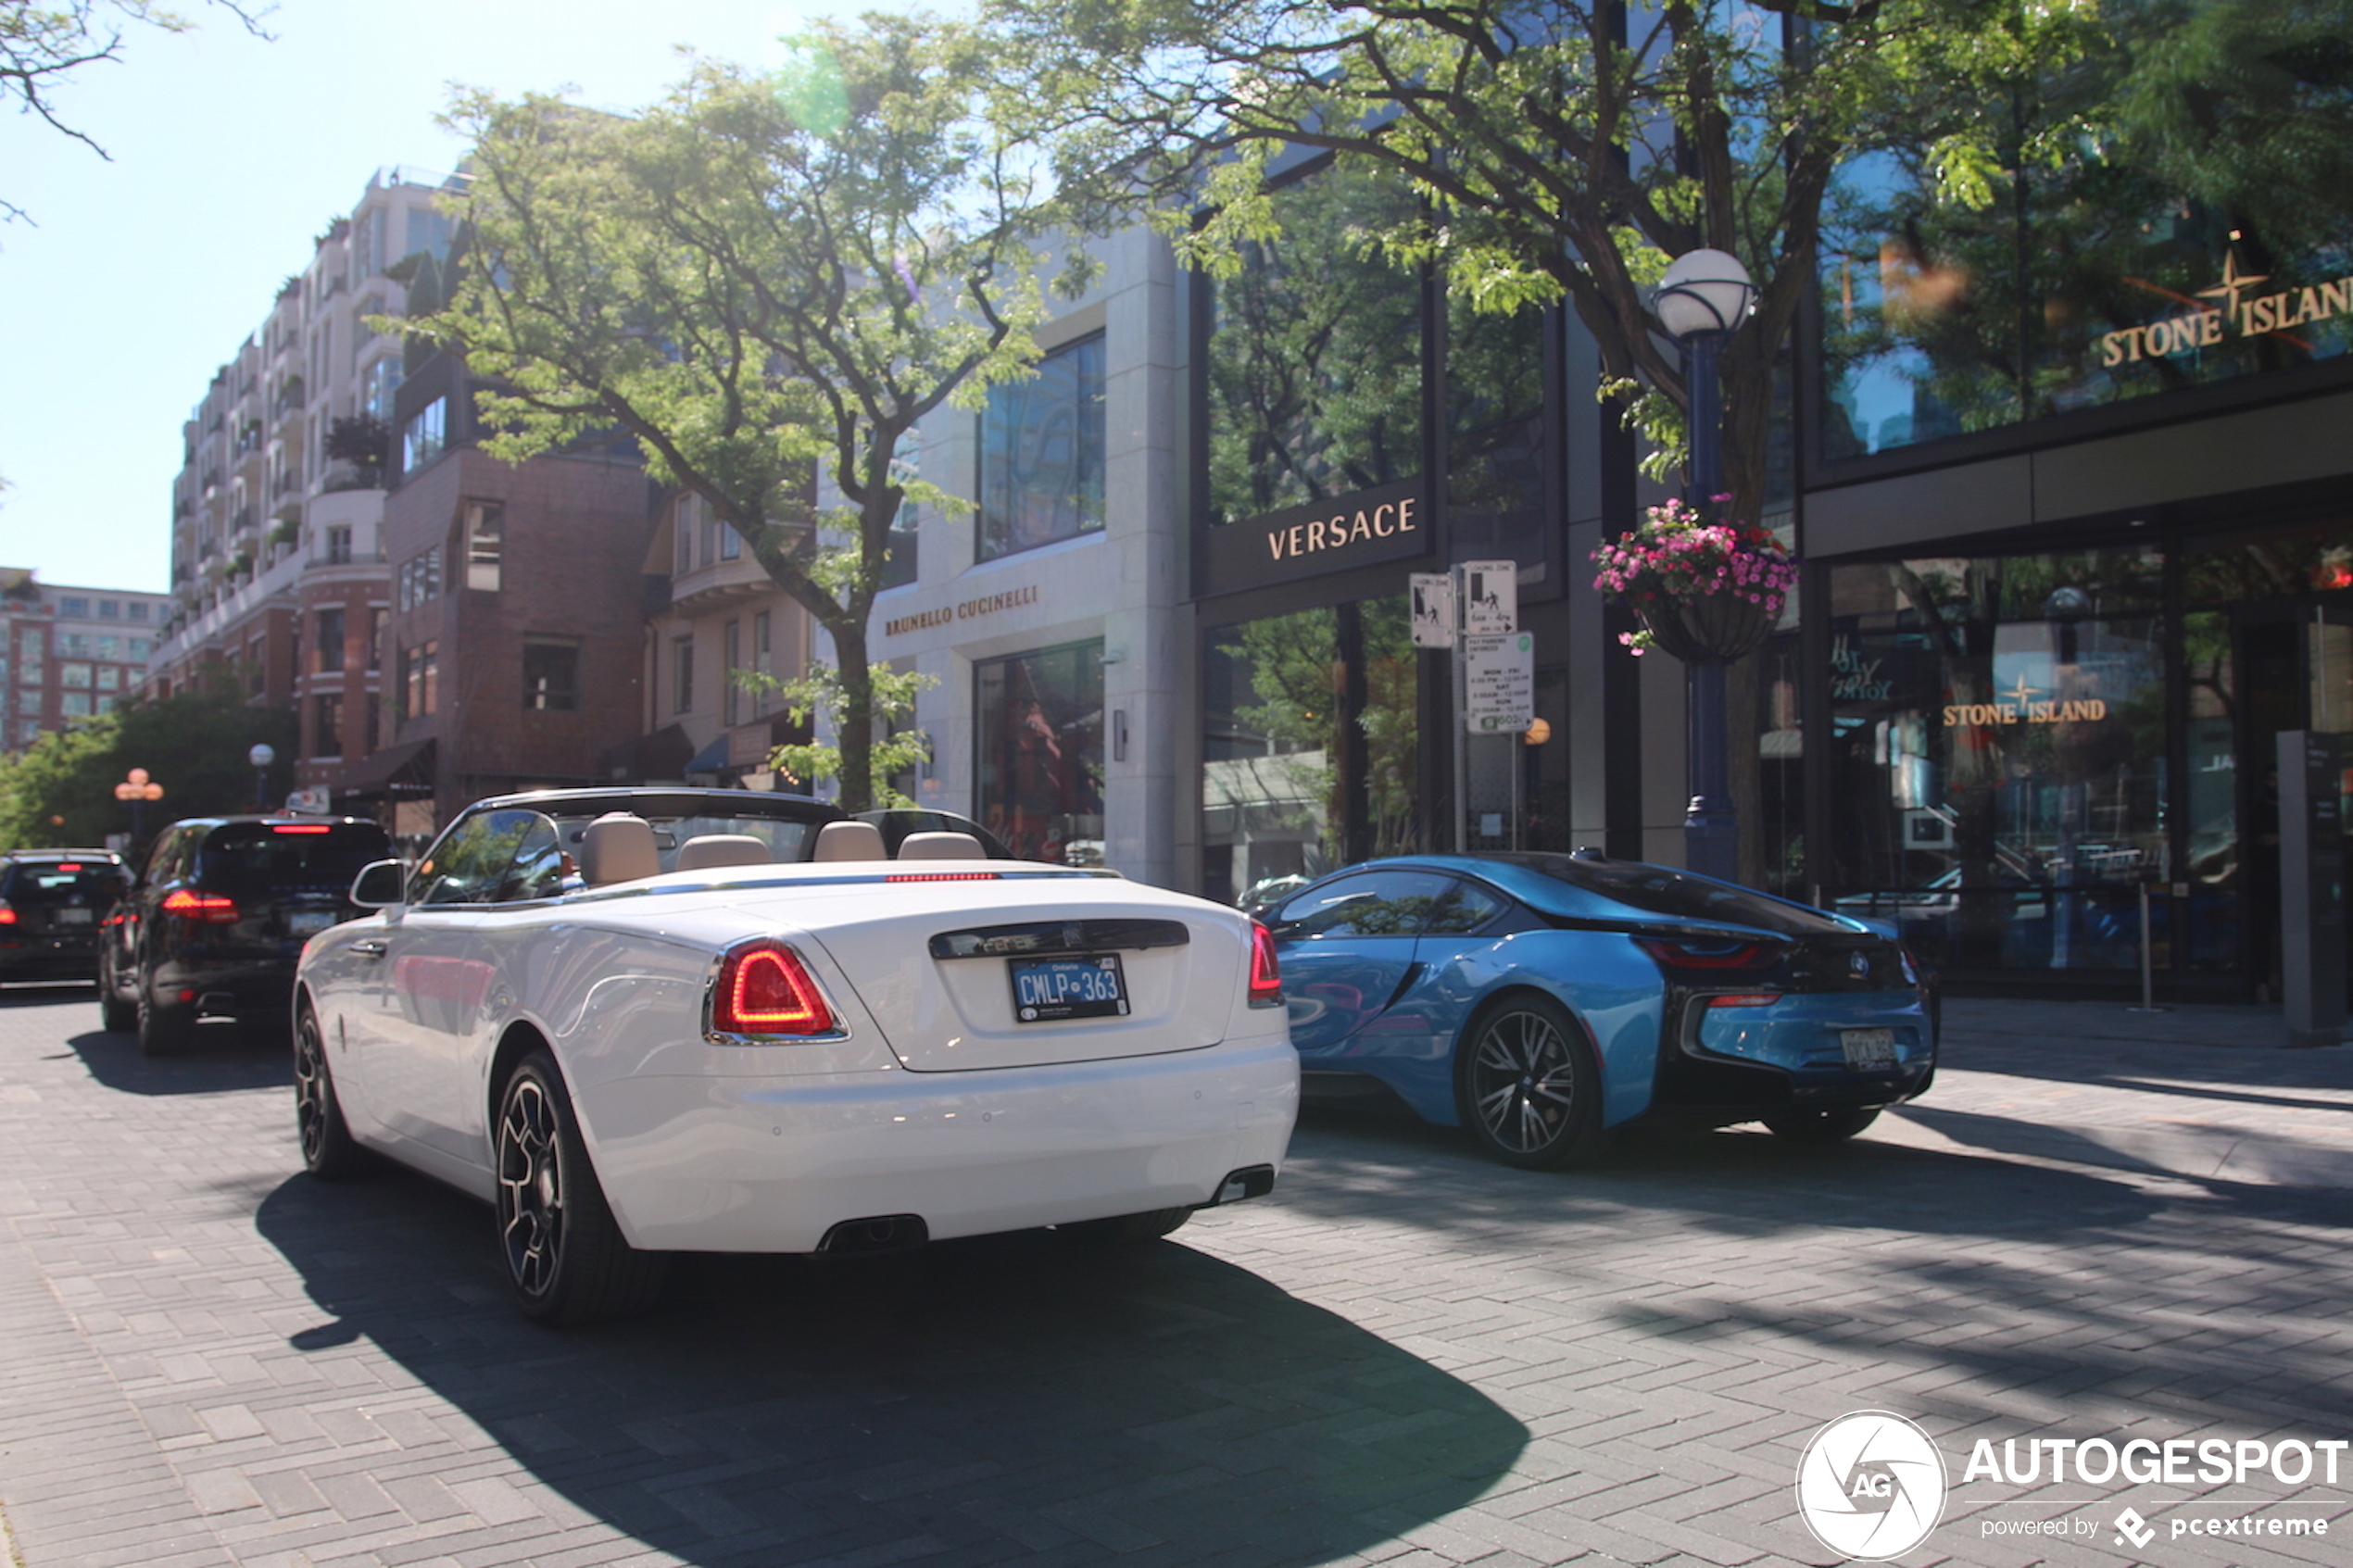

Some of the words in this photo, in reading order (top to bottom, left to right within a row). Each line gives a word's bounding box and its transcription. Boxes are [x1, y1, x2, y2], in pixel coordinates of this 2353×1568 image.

[2102, 308, 2223, 367] STONE
[2240, 276, 2353, 337] ISLAN
[1268, 497, 1416, 560] VERSACE
[886, 607, 952, 636] BRUNELLO
[958, 585, 1038, 619] CUCINELLI
[1943, 703, 2018, 727] STONE
[2027, 698, 2107, 723] ISLAND
[1020, 972, 1068, 1006] CMLP
[1081, 970, 1118, 1001] 363
[1051, 963, 1079, 972] Ontario
